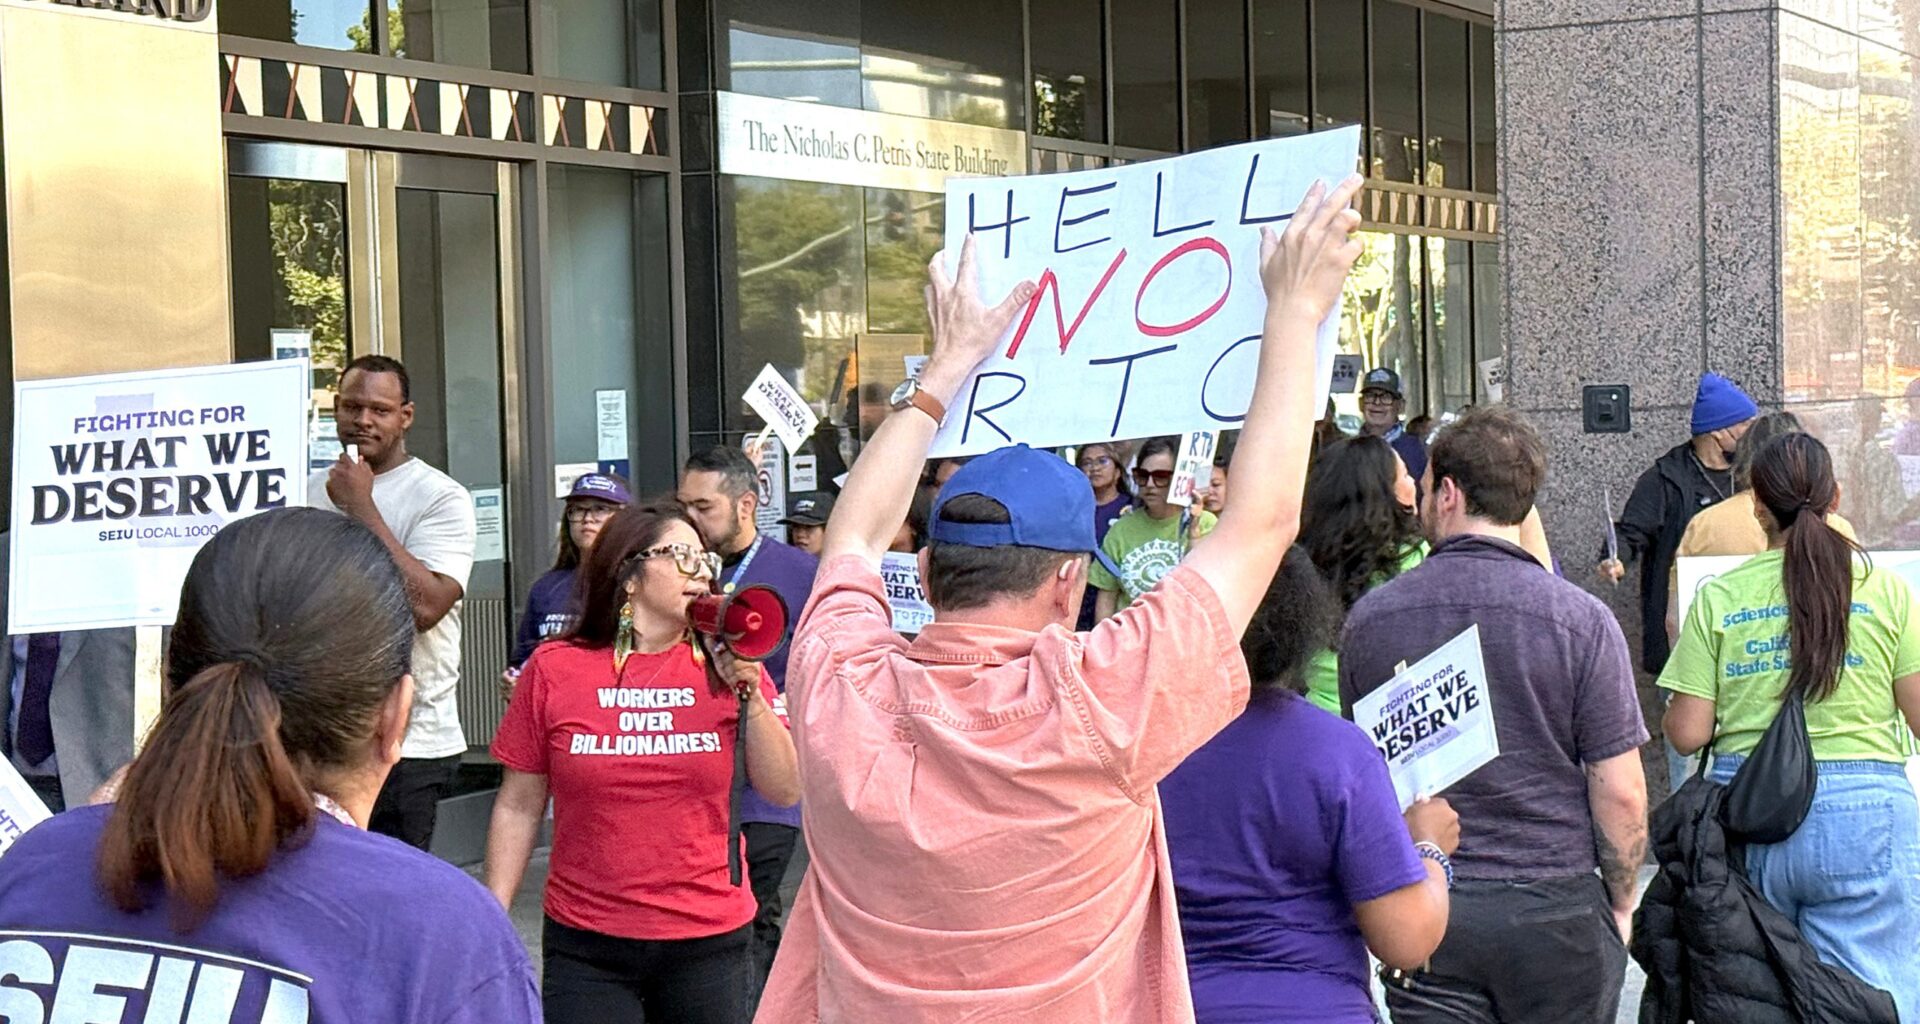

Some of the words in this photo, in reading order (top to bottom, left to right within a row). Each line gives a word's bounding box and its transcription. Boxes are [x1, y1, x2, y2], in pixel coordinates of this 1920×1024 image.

[743, 119, 778, 153] The
[783, 124, 850, 161] Nicholas
[854, 133, 871, 163] C.
[873, 135, 912, 167] Petris
[916, 140, 950, 171] State
[954, 145, 1009, 177] Building
[968, 153, 1296, 258] HELL
[1006, 236, 1232, 360] NO
[73, 409, 194, 434] FIGHTING
[200, 405, 246, 425] FOR
[758, 382, 805, 437] DESERVE
[768, 381, 793, 408] WHAT
[795, 410, 807, 427] WE
[49, 436, 188, 476] WHAT
[202, 429, 271, 466] WE
[30, 468, 287, 526] DESERVE
[99, 529, 134, 541] SEIU
[136, 526, 182, 539] LOCAL
[184, 525, 219, 537] 1000
[881, 572, 909, 584] HAT
[886, 584, 925, 601] SERV
[1380, 679, 1432, 717] FIGHTING
[1433, 664, 1454, 685] FOR
[1726, 658, 1770, 677] State
[597, 687, 695, 708] WORKERS
[1372, 694, 1430, 742] WHAT
[1436, 670, 1468, 701] WE
[570, 732, 722, 756] BILLIONAIRES!
[618, 711, 674, 732] OVER
